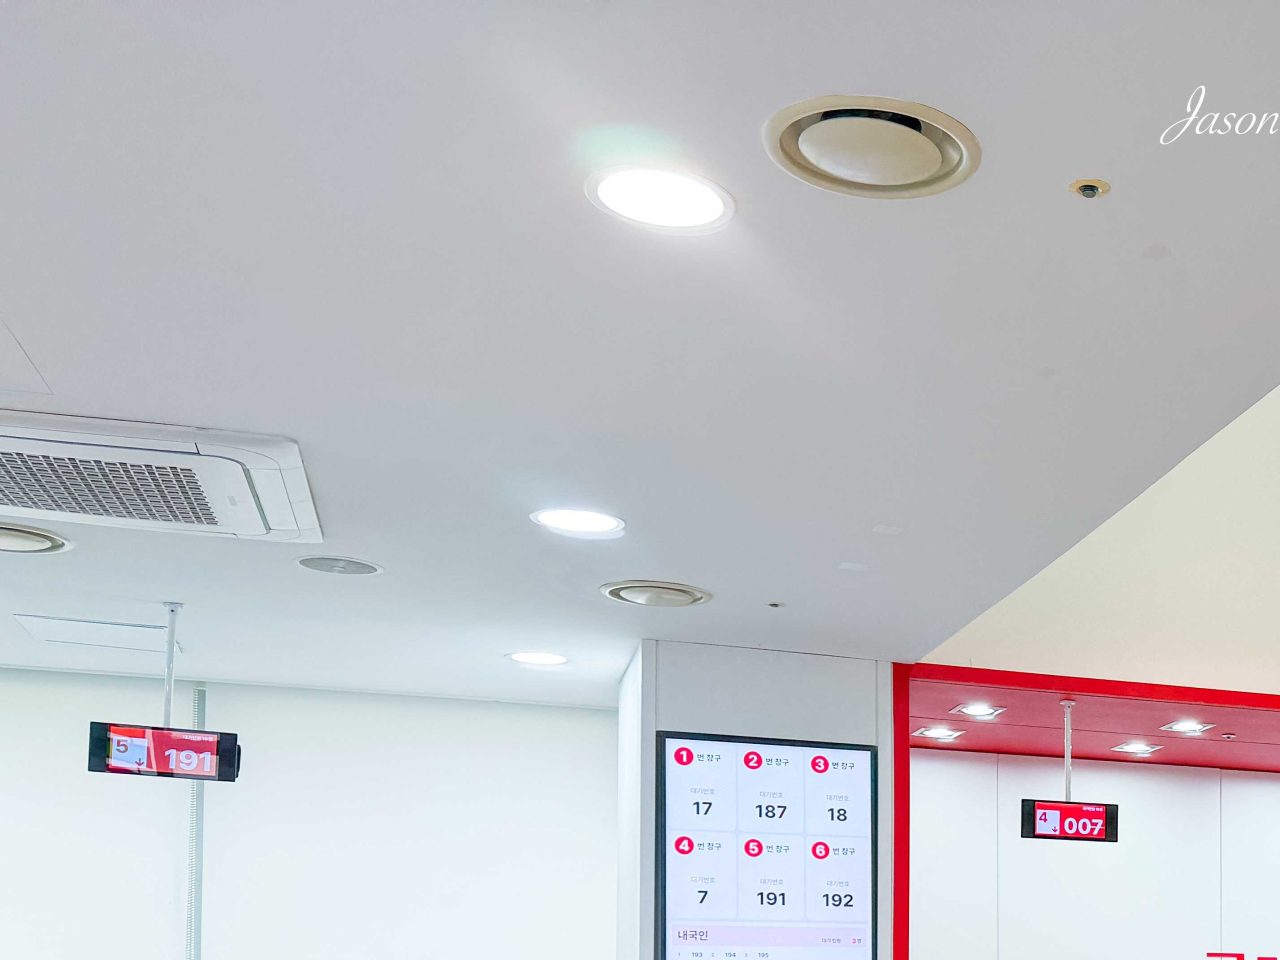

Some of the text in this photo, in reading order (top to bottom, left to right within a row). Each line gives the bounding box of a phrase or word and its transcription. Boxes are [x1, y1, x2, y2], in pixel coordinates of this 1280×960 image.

[116, 739, 128, 753] 5
[165, 750, 211, 772] 191
[693, 802, 713, 815] 17
[755, 804, 787, 819] 187
[827, 808, 847, 822] 18
[1039, 812, 1048, 823] 4
[1064, 817, 1103, 835] 007
[697, 891, 708, 904] 7
[756, 892, 786, 906] 191
[822, 893, 854, 907] 192
[678, 930, 708, 941] 내국인
